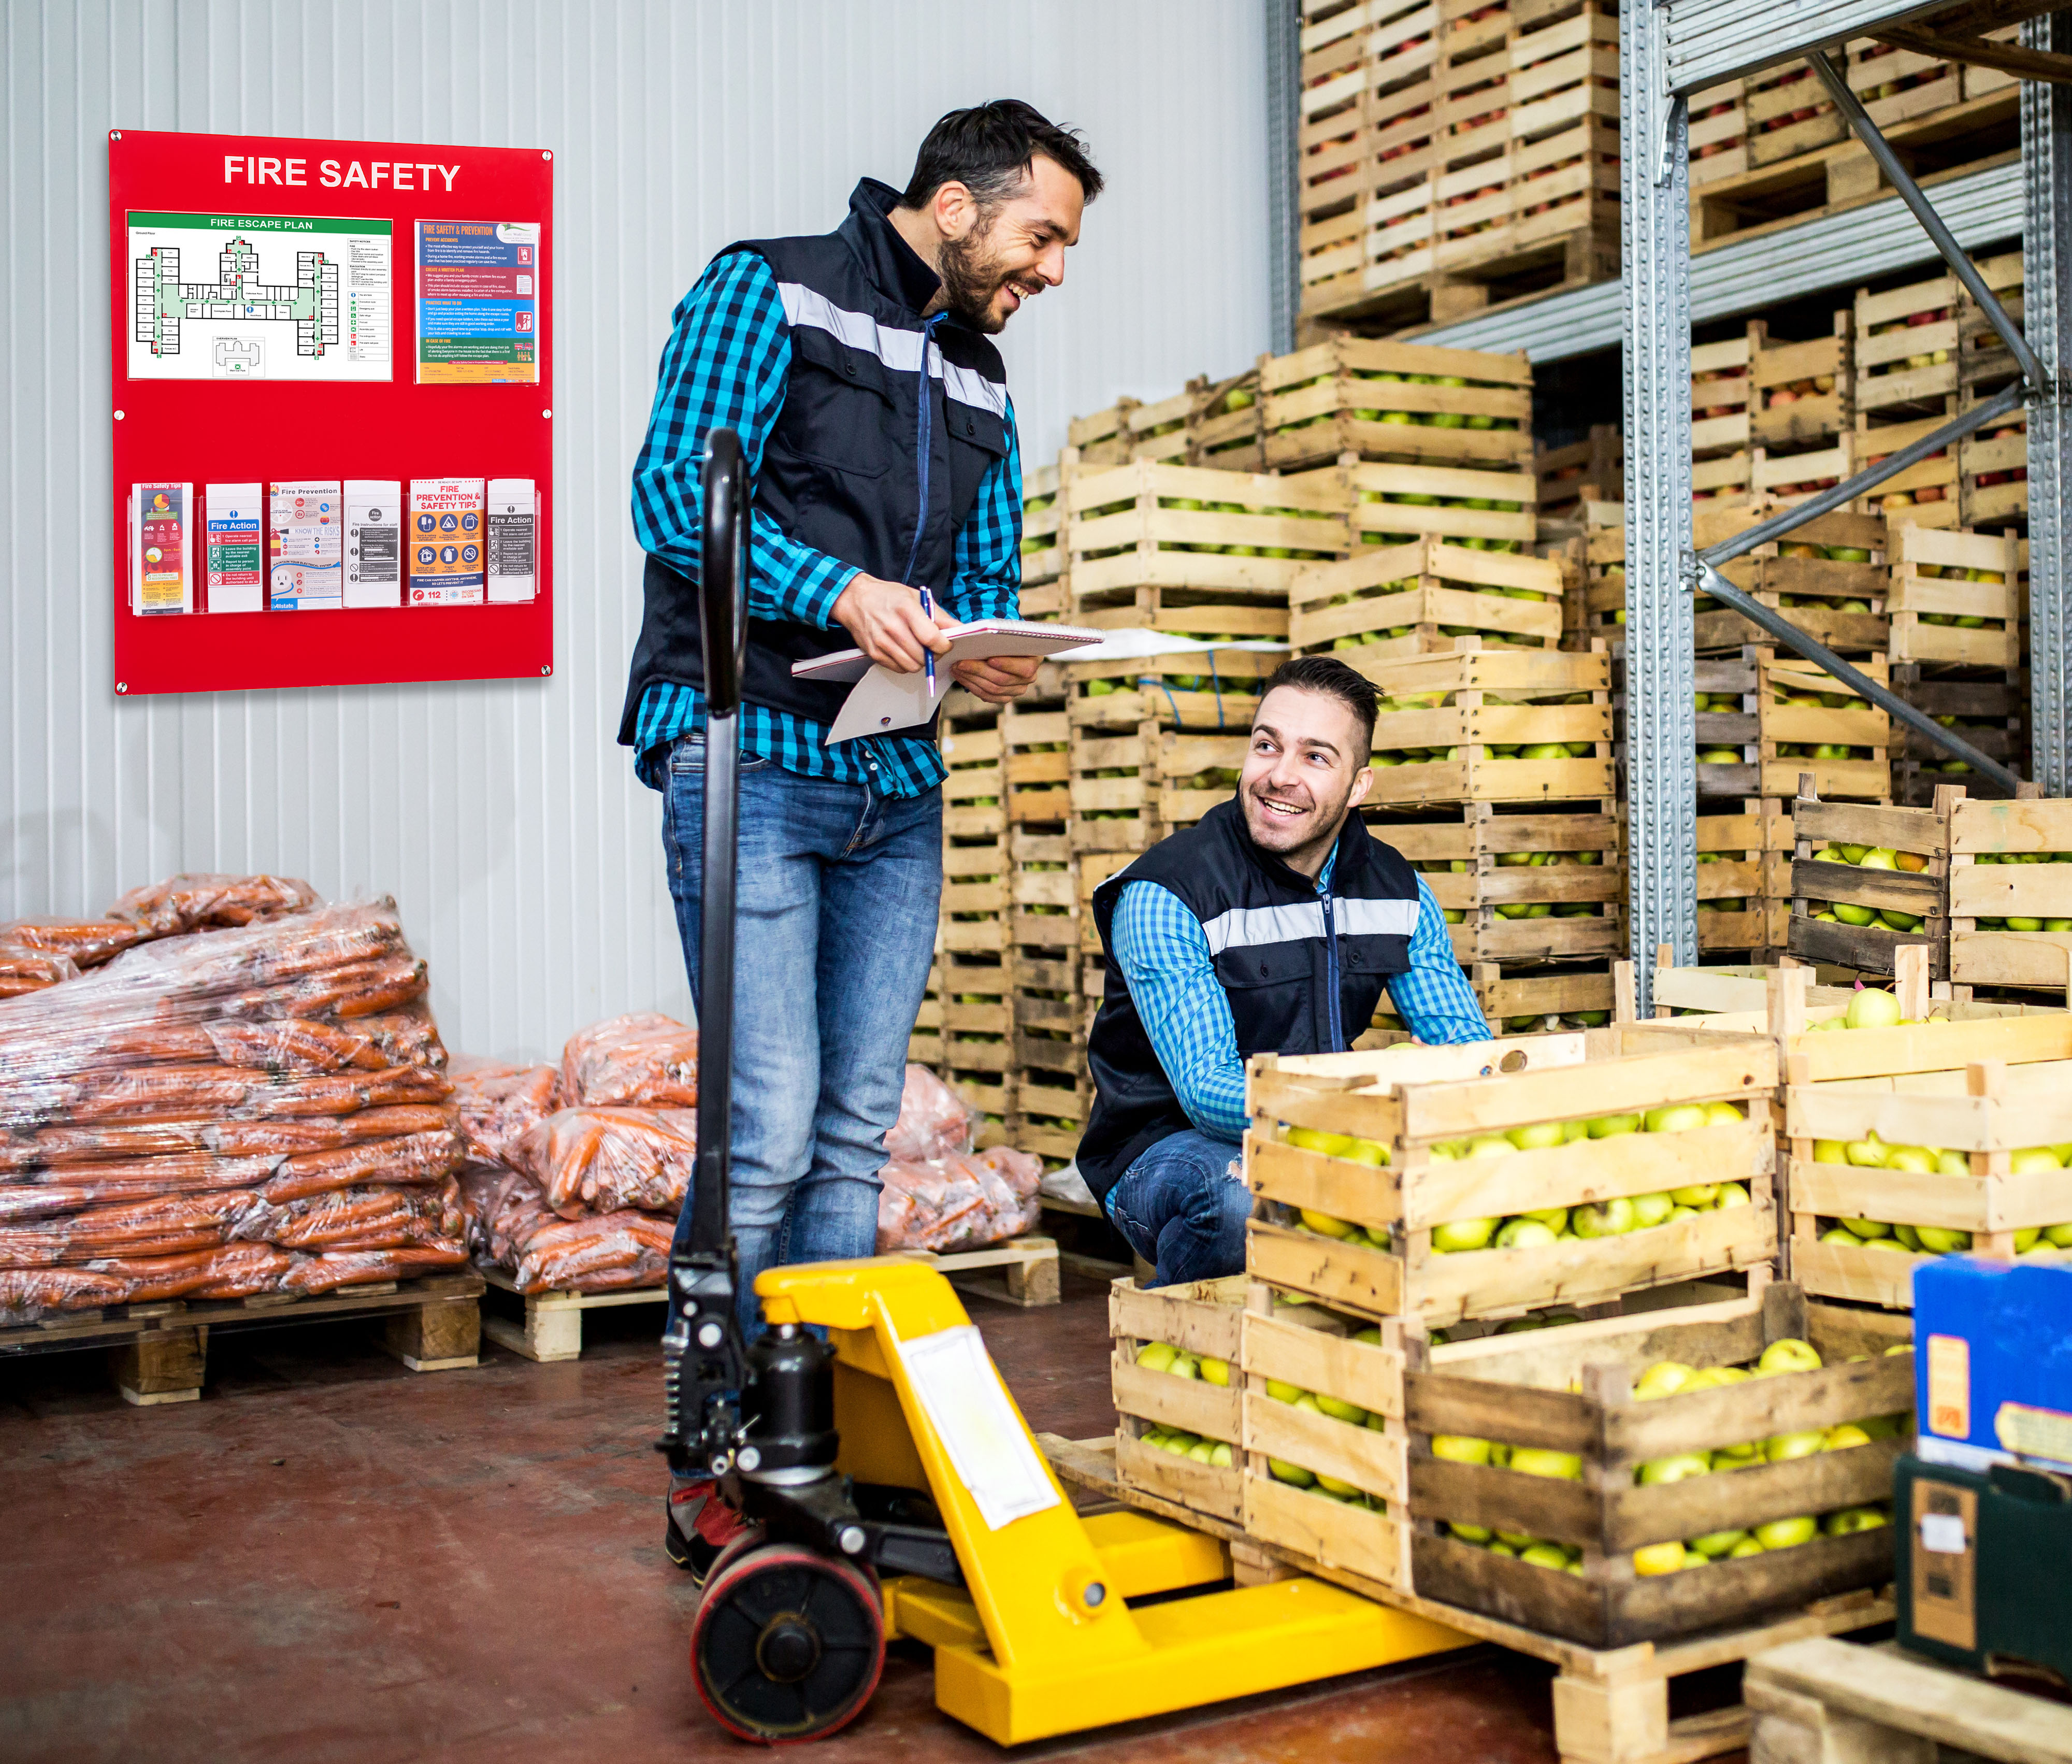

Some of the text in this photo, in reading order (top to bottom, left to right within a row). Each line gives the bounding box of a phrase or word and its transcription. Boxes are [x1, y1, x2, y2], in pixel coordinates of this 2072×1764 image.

[225, 156, 461, 192] FIRE SAFETY
[211, 219, 312, 229] FIRE ESCAPE PLAN
[424, 225, 493, 236] FIRE SAFETY & PREVENTION
[417, 493, 473, 501] PREVENTION
[313, 527, 323, 535] THE
[324, 526, 340, 536] RISKS
